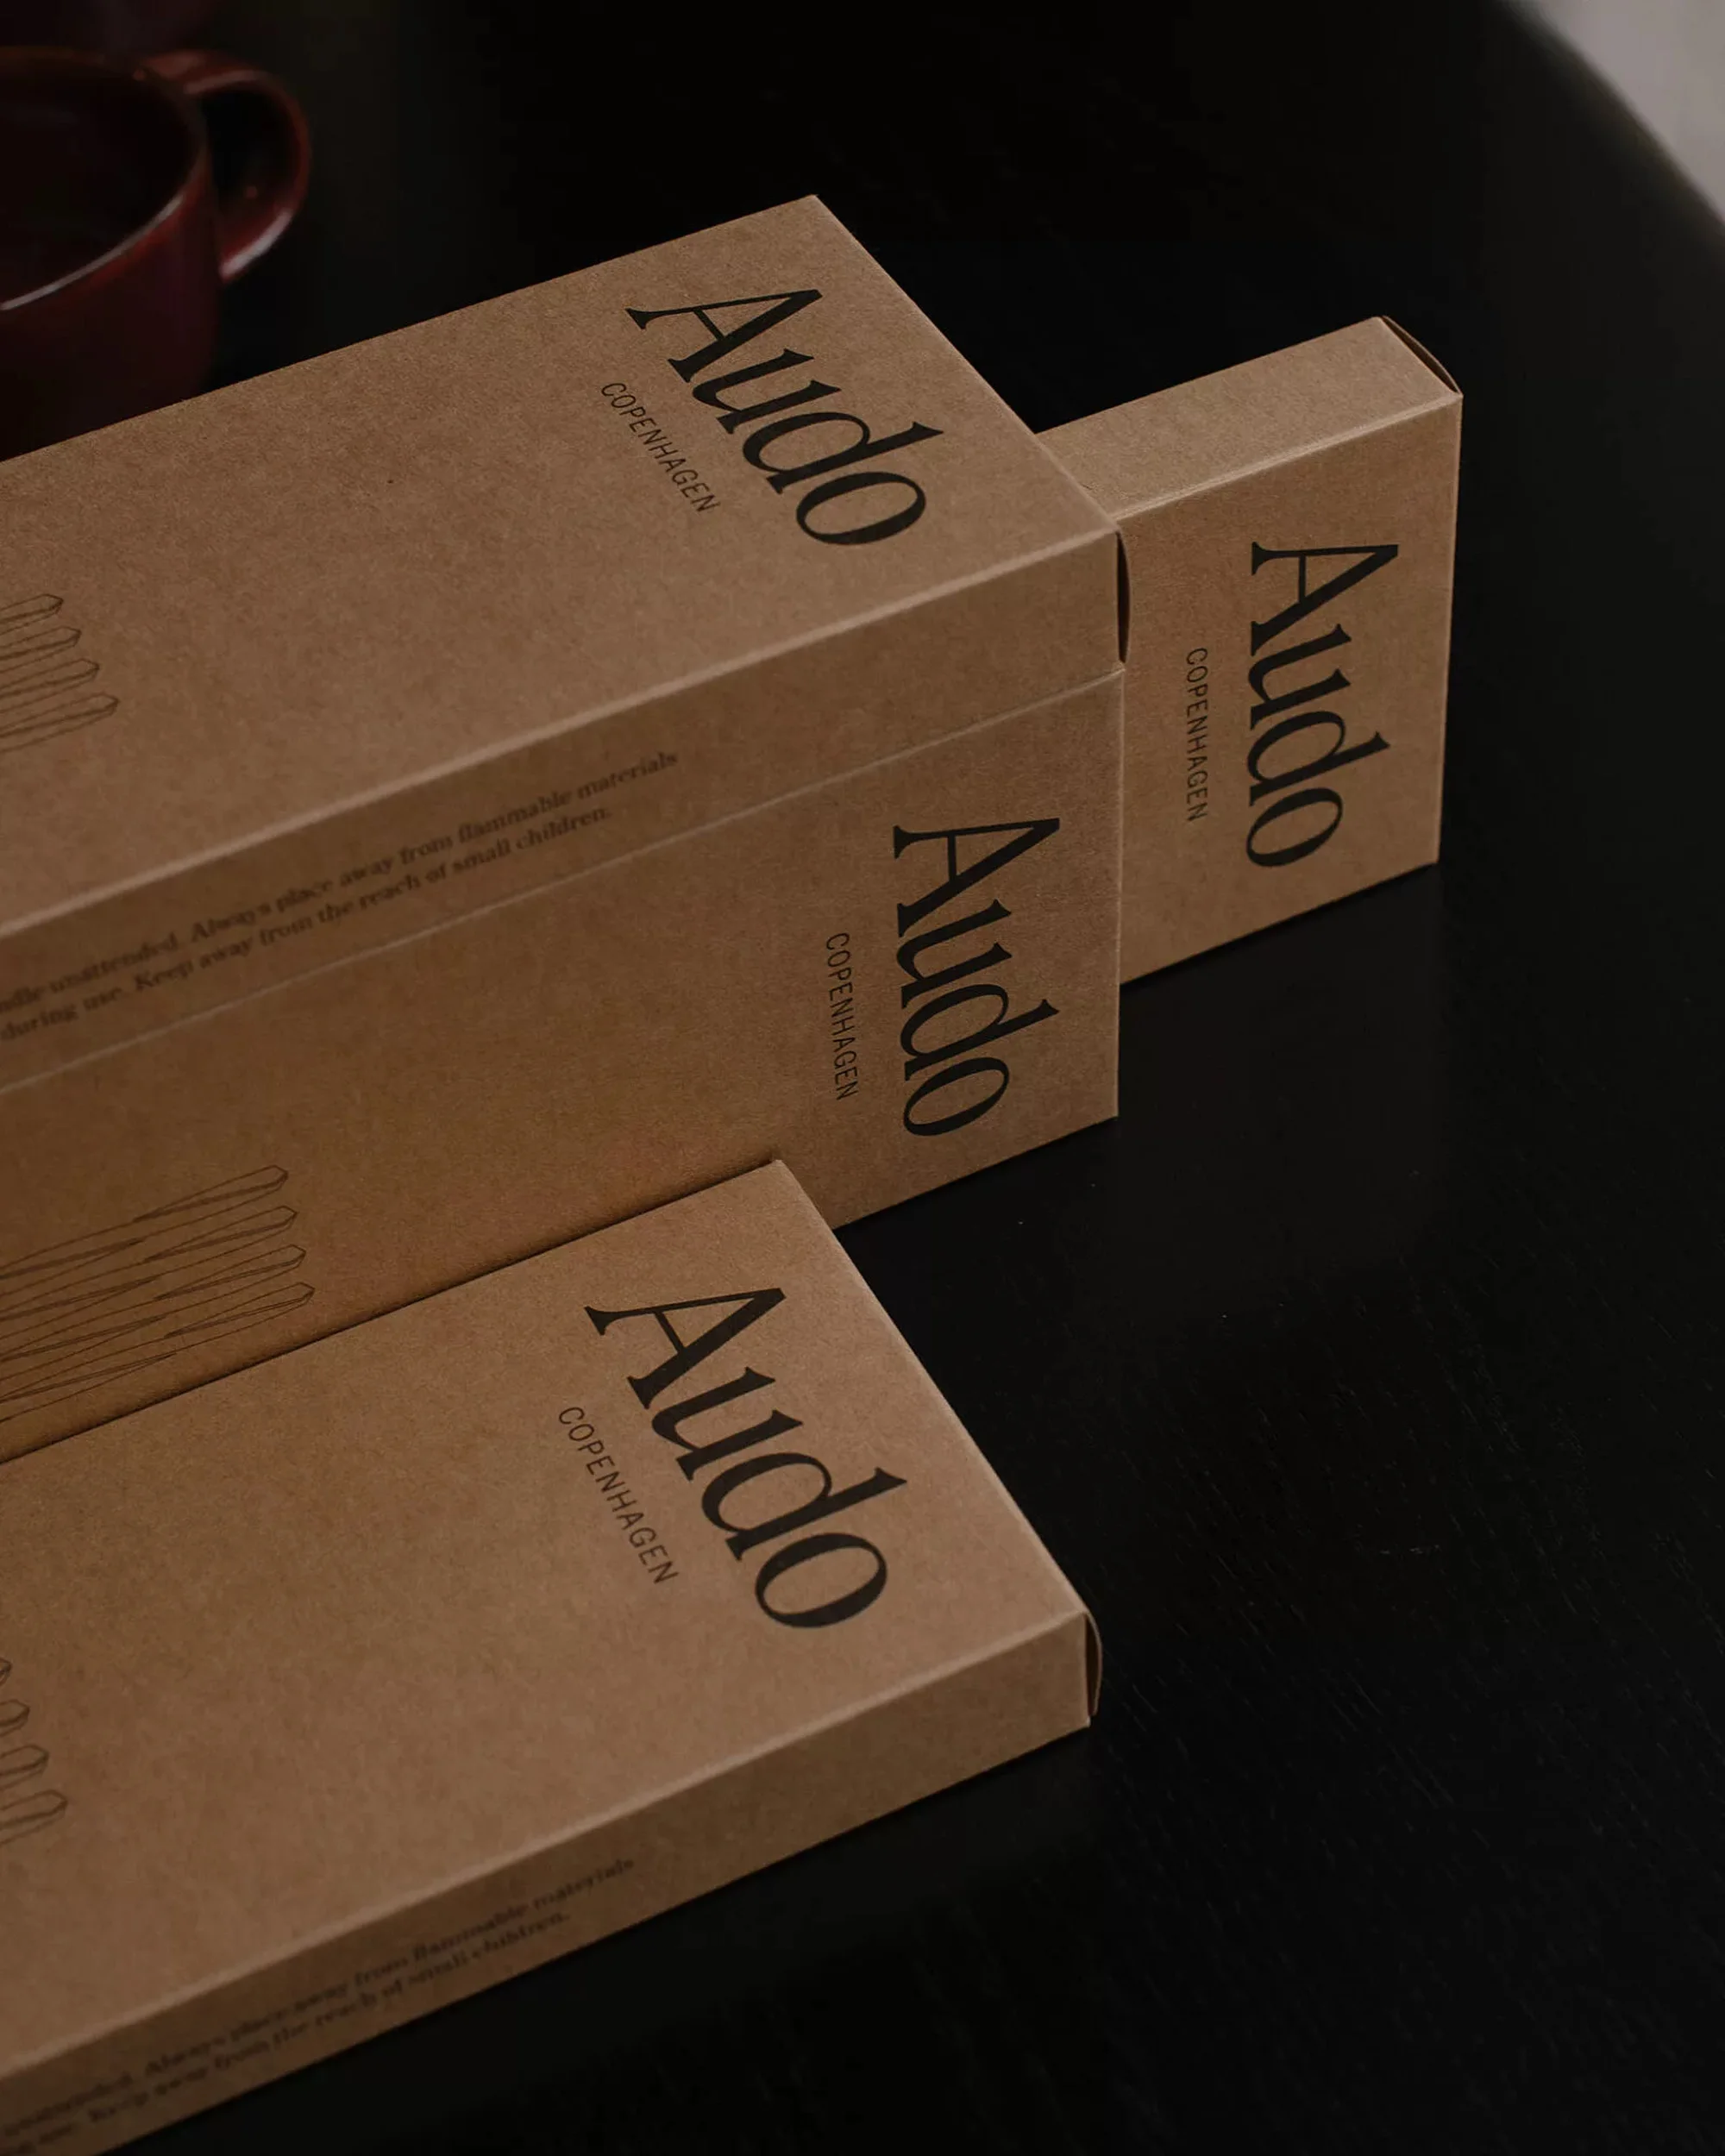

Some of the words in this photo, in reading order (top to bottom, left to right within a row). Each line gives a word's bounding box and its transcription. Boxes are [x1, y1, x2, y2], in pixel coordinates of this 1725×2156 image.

[601, 382, 719, 512] COPENHAGEN
[625, 289, 944, 545] Audo
[1186, 648, 1208, 822] COPENHAGEN
[1246, 542, 1399, 867] Audo
[339, 856, 395, 887] away
[399, 837, 454, 865] from
[458, 791, 573, 844] flammable
[577, 752, 678, 800] materials
[134, 959, 194, 992] Keep
[199, 937, 254, 969] away
[260, 916, 313, 946] from
[317, 902, 354, 924] the
[360, 874, 421, 910] reach
[424, 863, 447, 884] of
[452, 837, 511, 874] small
[893, 818, 1060, 1136] Audo
[825, 932, 859, 1101] COPENHAGEN
[558, 1407, 680, 1584] COPENHAGEN
[584, 1288, 908, 1628] Audo
